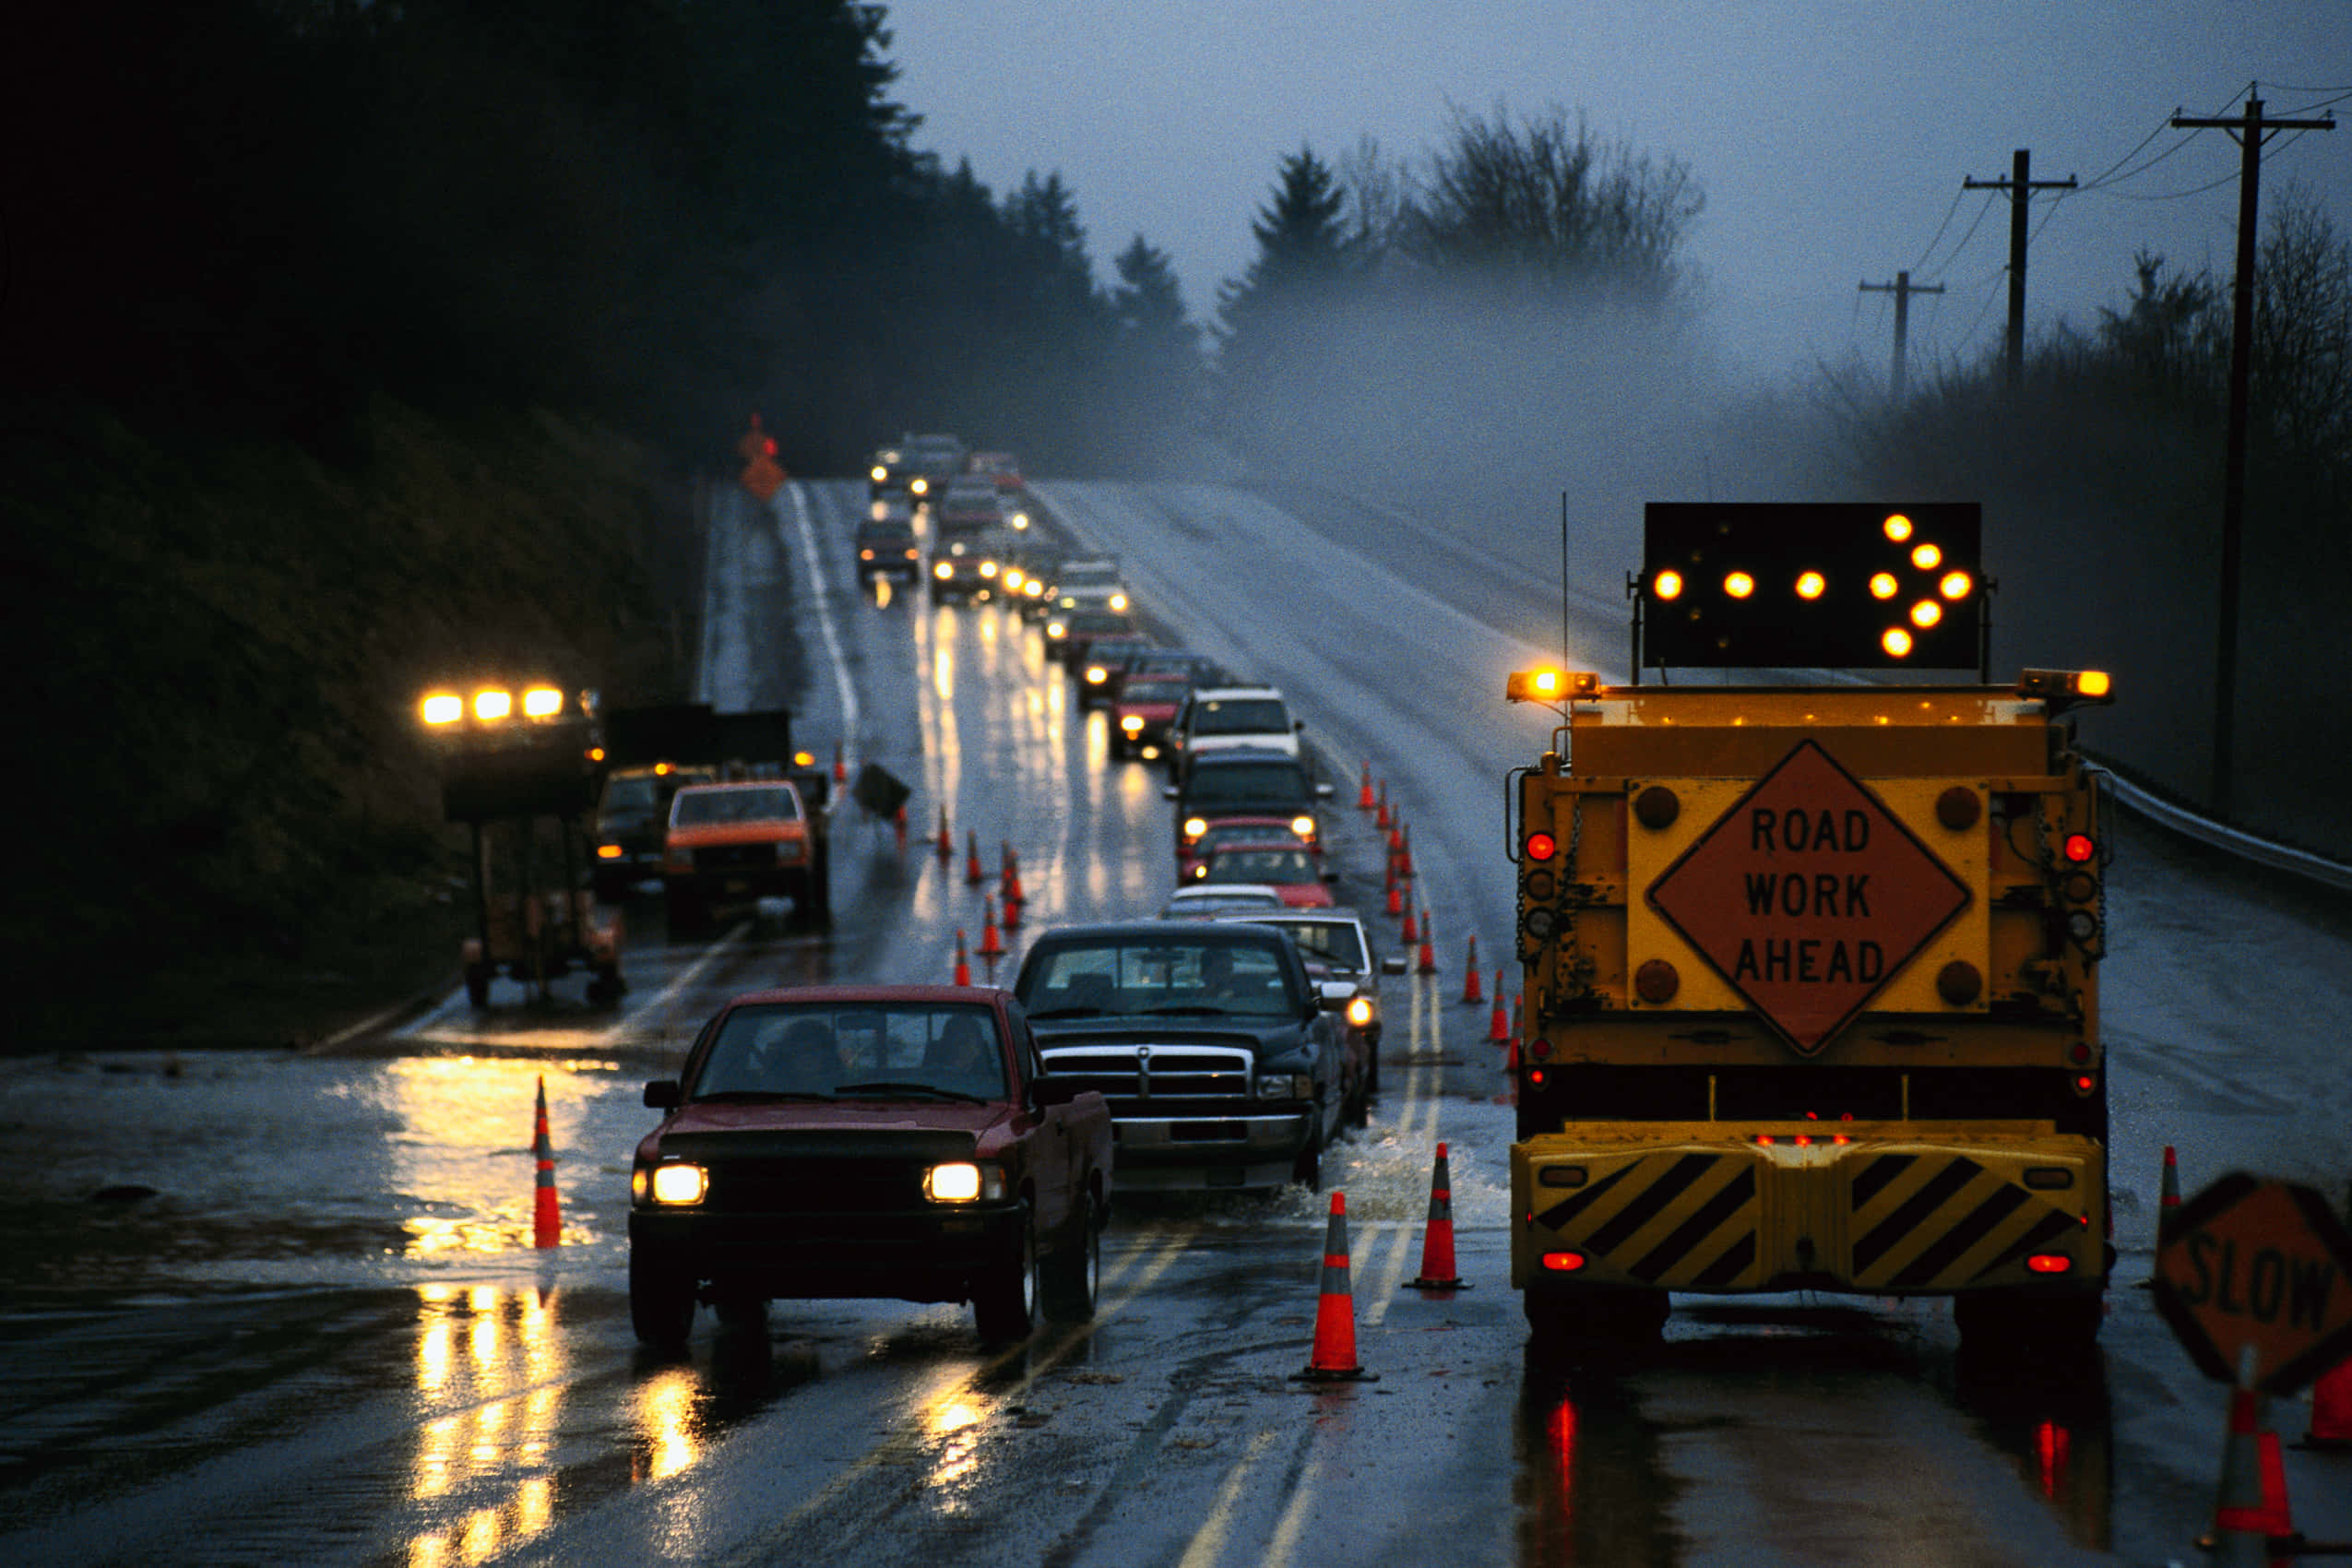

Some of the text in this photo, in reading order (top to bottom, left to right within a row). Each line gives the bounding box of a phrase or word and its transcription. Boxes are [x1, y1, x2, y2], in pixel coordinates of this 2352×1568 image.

[1752, 809, 1870, 852] ROAD
[1745, 873, 1870, 917] WORK
[1735, 939, 1884, 983] AHEAD
[2175, 1231, 2334, 1333] SLOW
